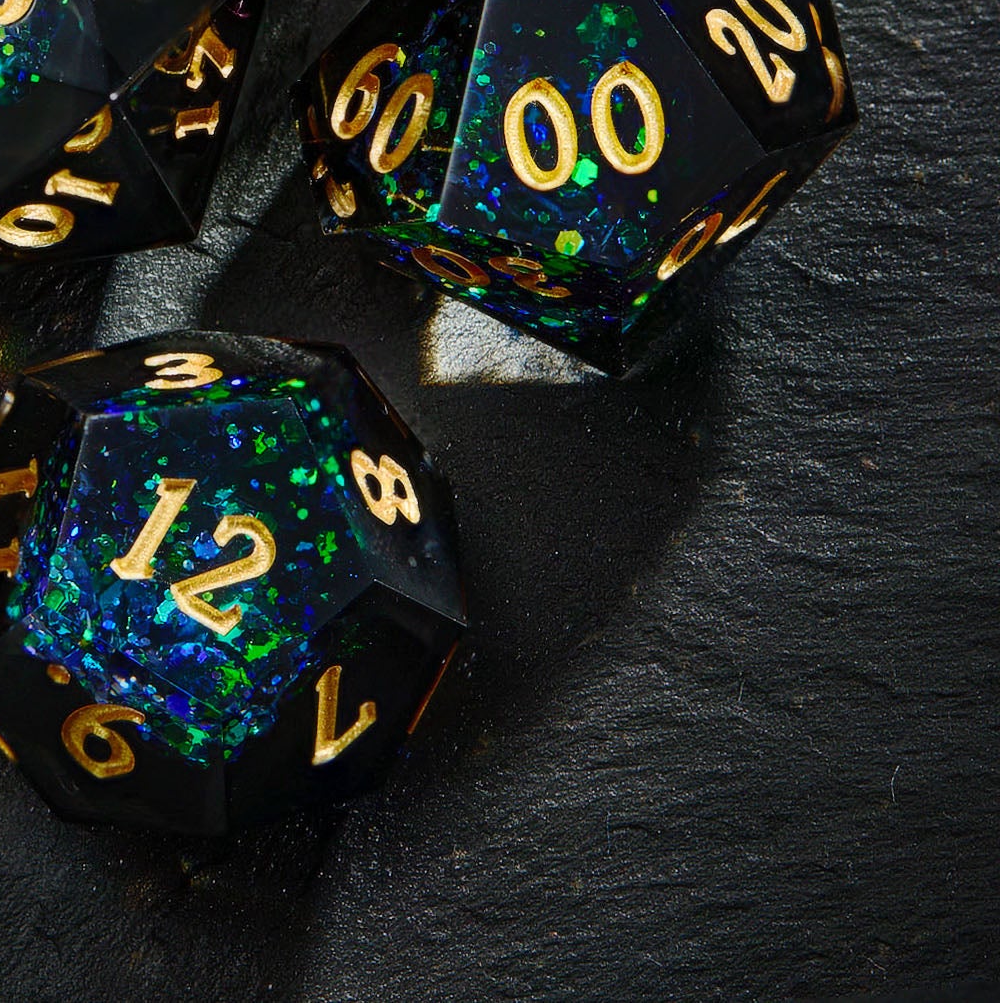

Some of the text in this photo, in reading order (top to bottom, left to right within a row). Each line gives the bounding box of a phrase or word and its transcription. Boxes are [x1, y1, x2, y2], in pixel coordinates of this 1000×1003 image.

[330, 43, 434, 174] 60
[503, 60, 666, 192] 00
[143, 352, 223, 389] 3
[350, 449, 420, 525] 8
[110, 478, 277, 636] 12
